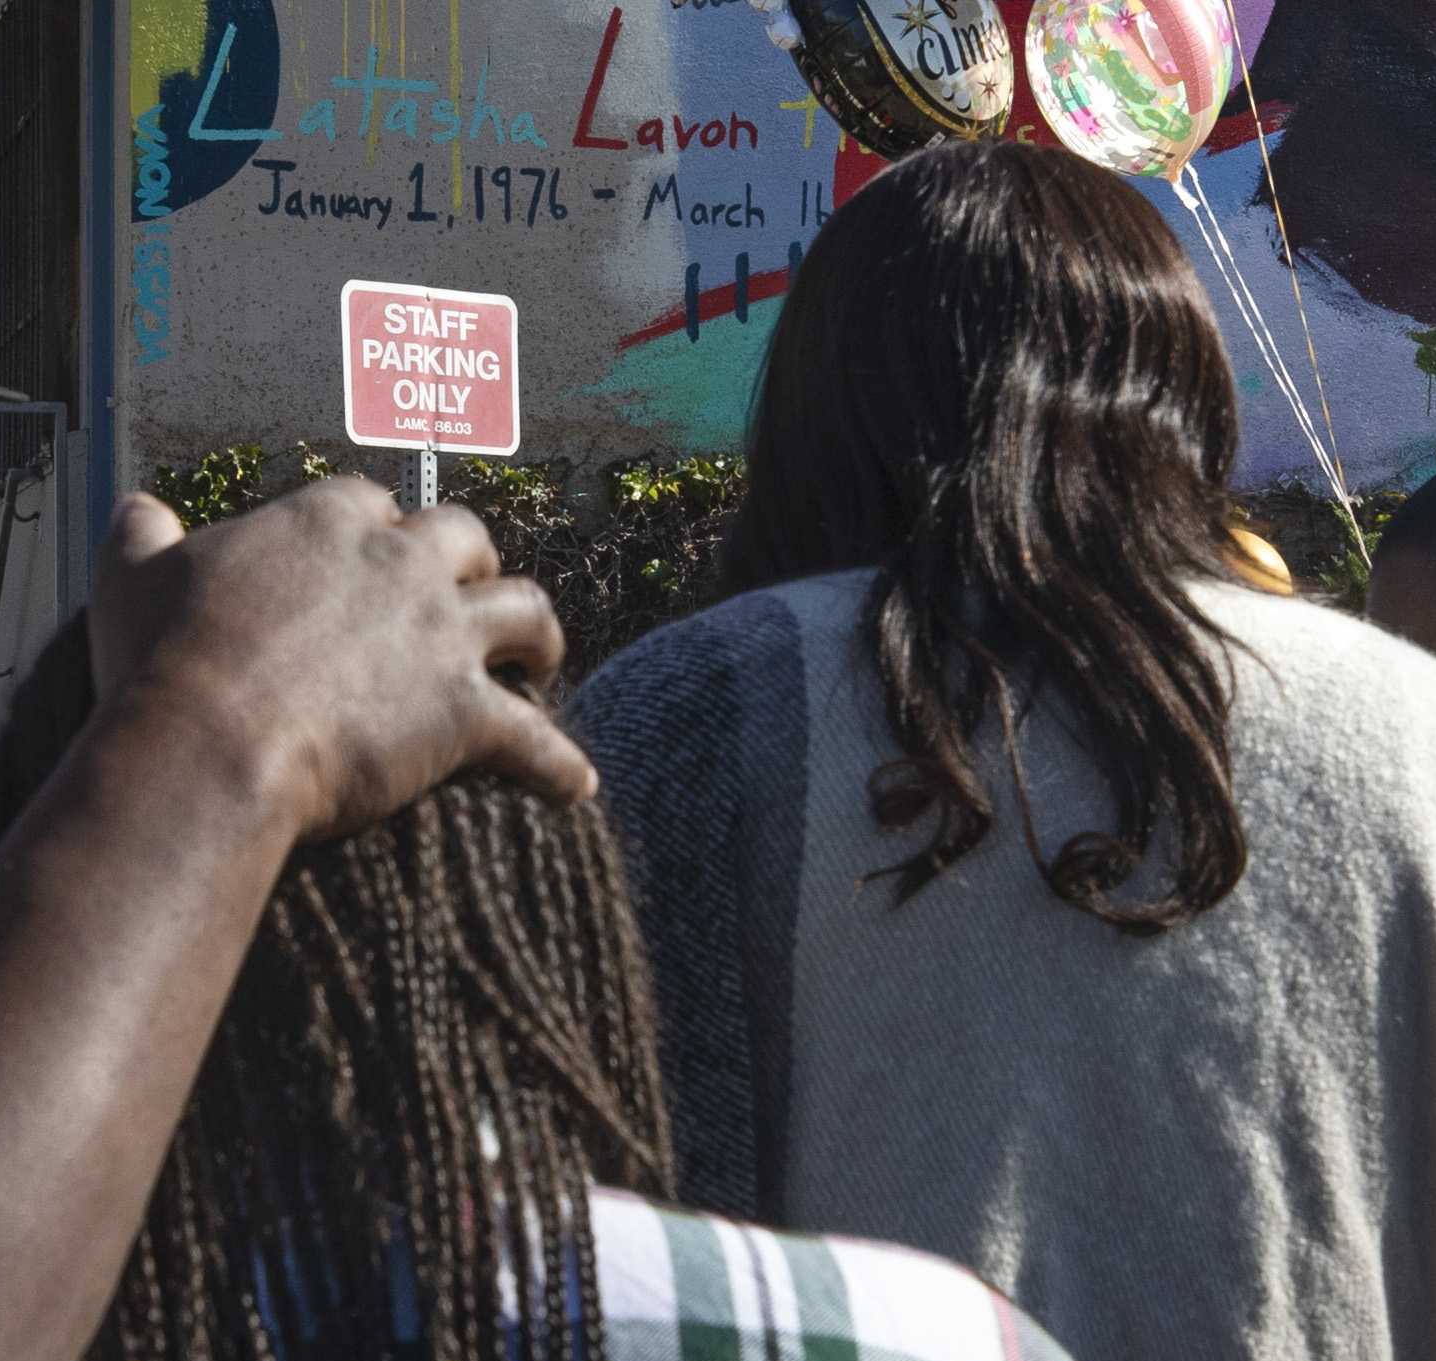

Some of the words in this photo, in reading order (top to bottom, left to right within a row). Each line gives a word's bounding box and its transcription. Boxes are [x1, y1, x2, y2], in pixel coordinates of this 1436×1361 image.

[188, 23, 548, 147] Latasha
[573, 6, 759, 153] Lavon
[252, 159, 392, 230] January
[407, 162, 455, 230] 1,
[473, 165, 569, 228] 1976
[643, 172, 765, 228] March
[383, 302, 479, 341] STAFF
[362, 338, 501, 381] PARKING
[392, 378, 473, 415] ONLY
[433, 420, 473, 436] 86.03
